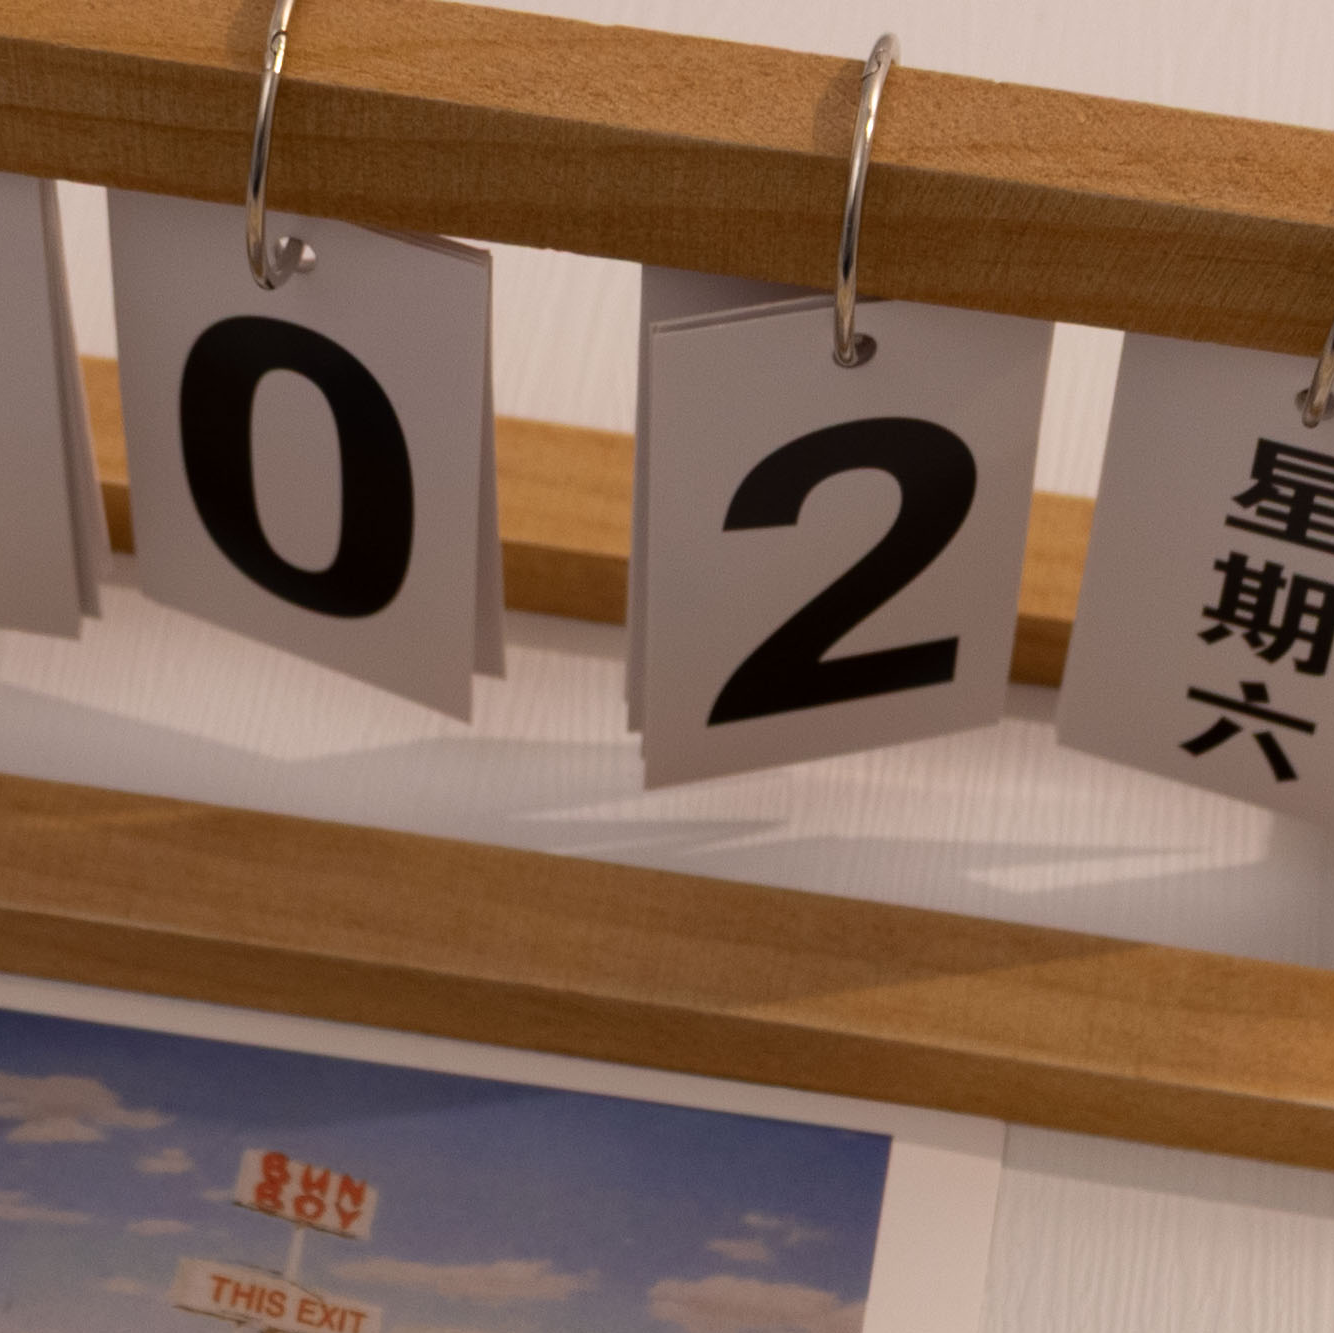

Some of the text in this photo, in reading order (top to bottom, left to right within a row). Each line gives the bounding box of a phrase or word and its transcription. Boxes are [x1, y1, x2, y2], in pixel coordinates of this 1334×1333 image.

[178, 315, 415, 619] 0
[706, 416, 977, 727] 2
[210, 1274, 287, 1318] THIS
